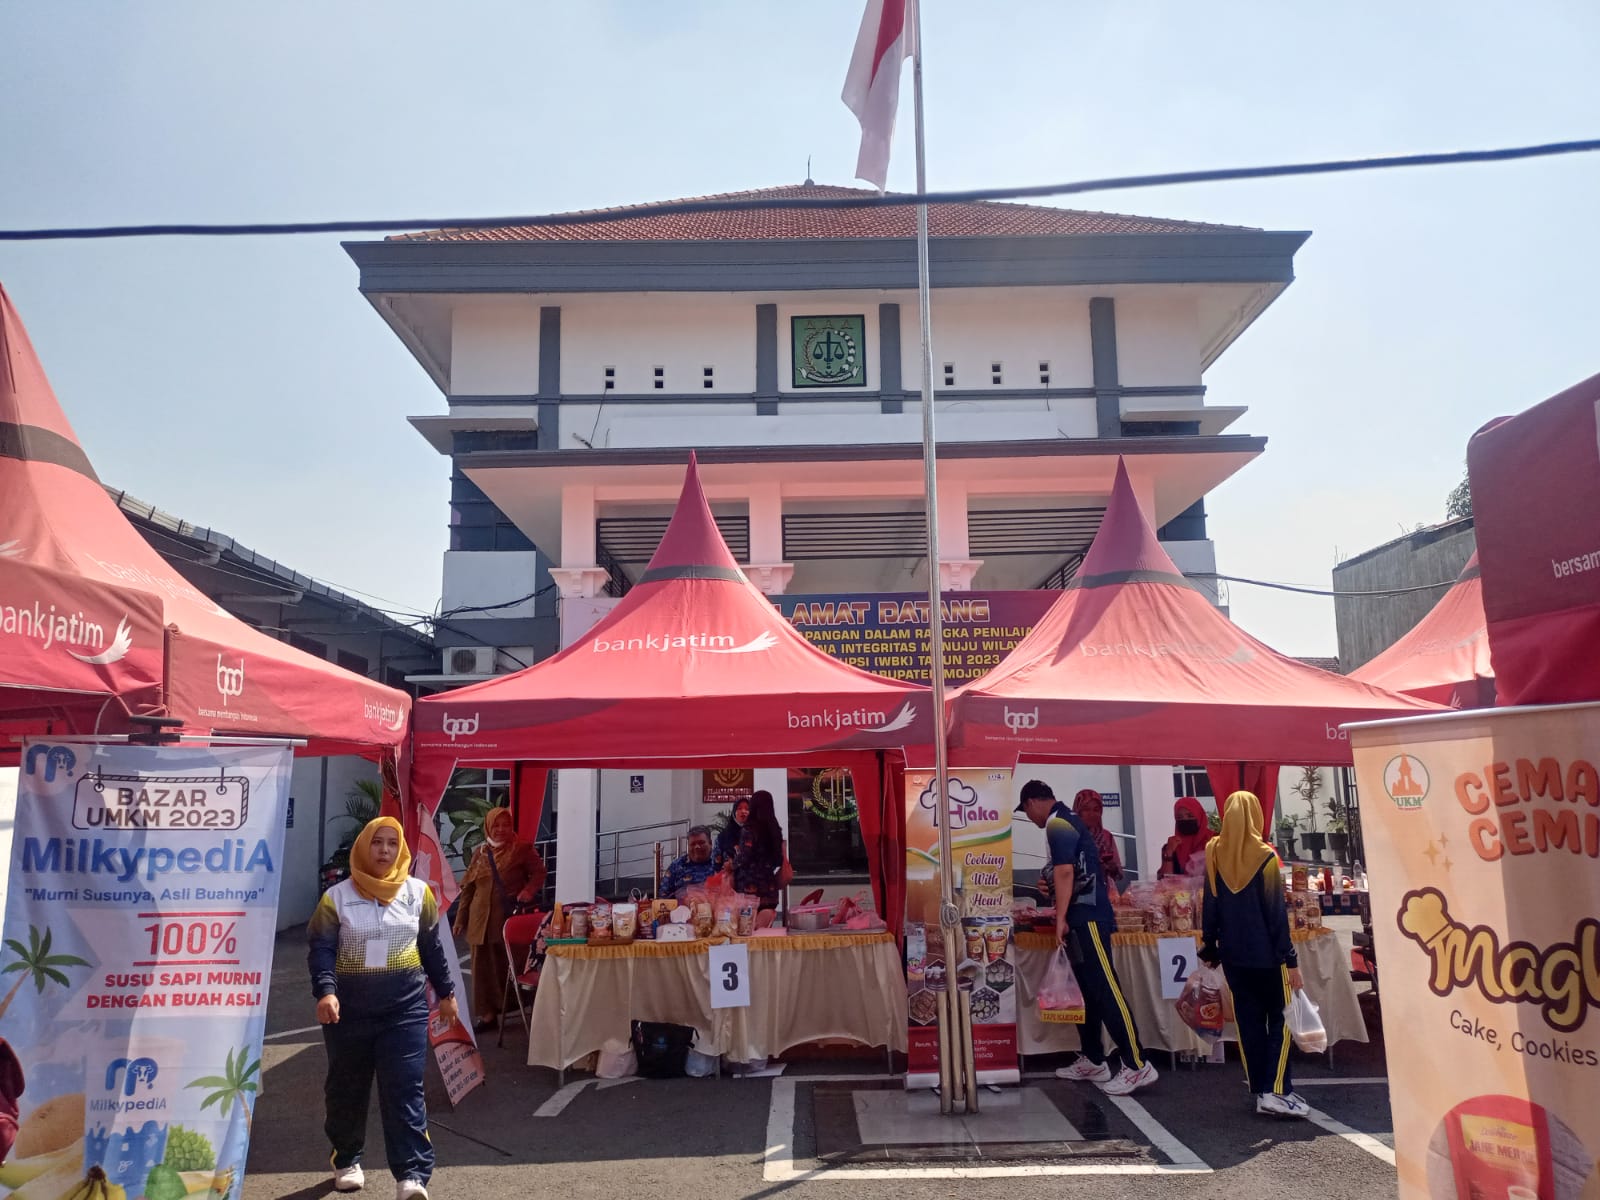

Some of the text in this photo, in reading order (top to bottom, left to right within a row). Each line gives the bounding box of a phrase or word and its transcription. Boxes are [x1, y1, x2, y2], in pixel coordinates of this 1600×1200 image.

[878, 599, 990, 625] DATANG
[592, 632, 735, 653] bankjatim
[801, 629, 860, 642] PANGAN
[864, 627, 911, 641] DALAM
[915, 627, 969, 640] RAGKA
[841, 642, 917, 654] INTEGRITAS
[921, 640, 978, 653] MNUJU
[843, 654, 1000, 668] UPSI (WBK) TAUN 2023
[787, 707, 886, 731] bankjatim
[116, 787, 207, 808] BAZAR
[1396, 796, 1423, 807] UKM
[86, 808, 235, 827] UMKM 2023
[22, 836, 274, 882] MilkypediA
[965, 852, 1006, 870] Cooking
[160, 886, 190, 901] Asli
[144, 920, 237, 956] 100%
[721, 961, 740, 992] 3
[1170, 953, 1188, 984] 2
[104, 971, 262, 989] SUSU SAPI MURNI
[87, 992, 261, 1009] DENGAN BUAH ASLI
[1450, 1009, 1598, 1067] Cake, Cookies
